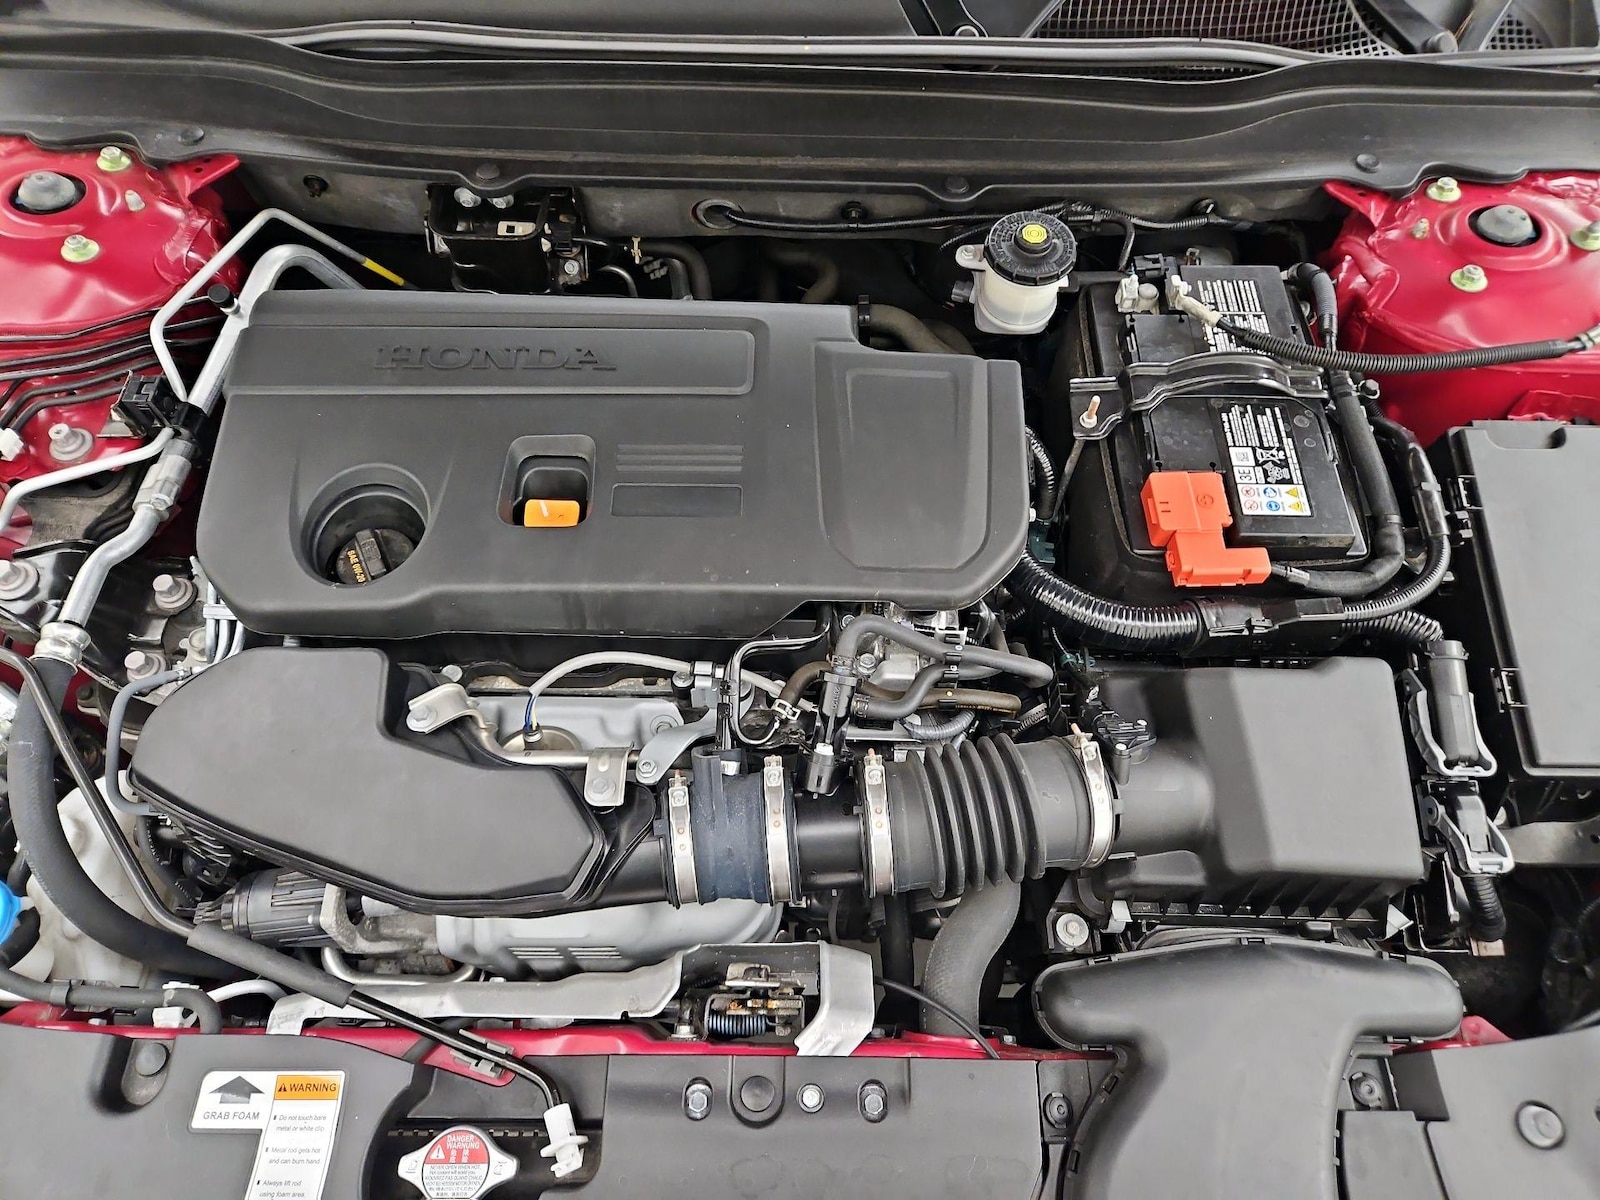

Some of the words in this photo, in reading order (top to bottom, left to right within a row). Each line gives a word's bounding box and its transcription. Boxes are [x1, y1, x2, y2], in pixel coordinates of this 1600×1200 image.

[374, 345, 617, 371] HONDA
[347, 550, 359, 564] SAE
[352, 564, 366, 582] 0W-20
[289, 1083, 337, 1092] WARNING
[203, 1112, 231, 1120] GRAB
[232, 1112, 260, 1120] FOAM
